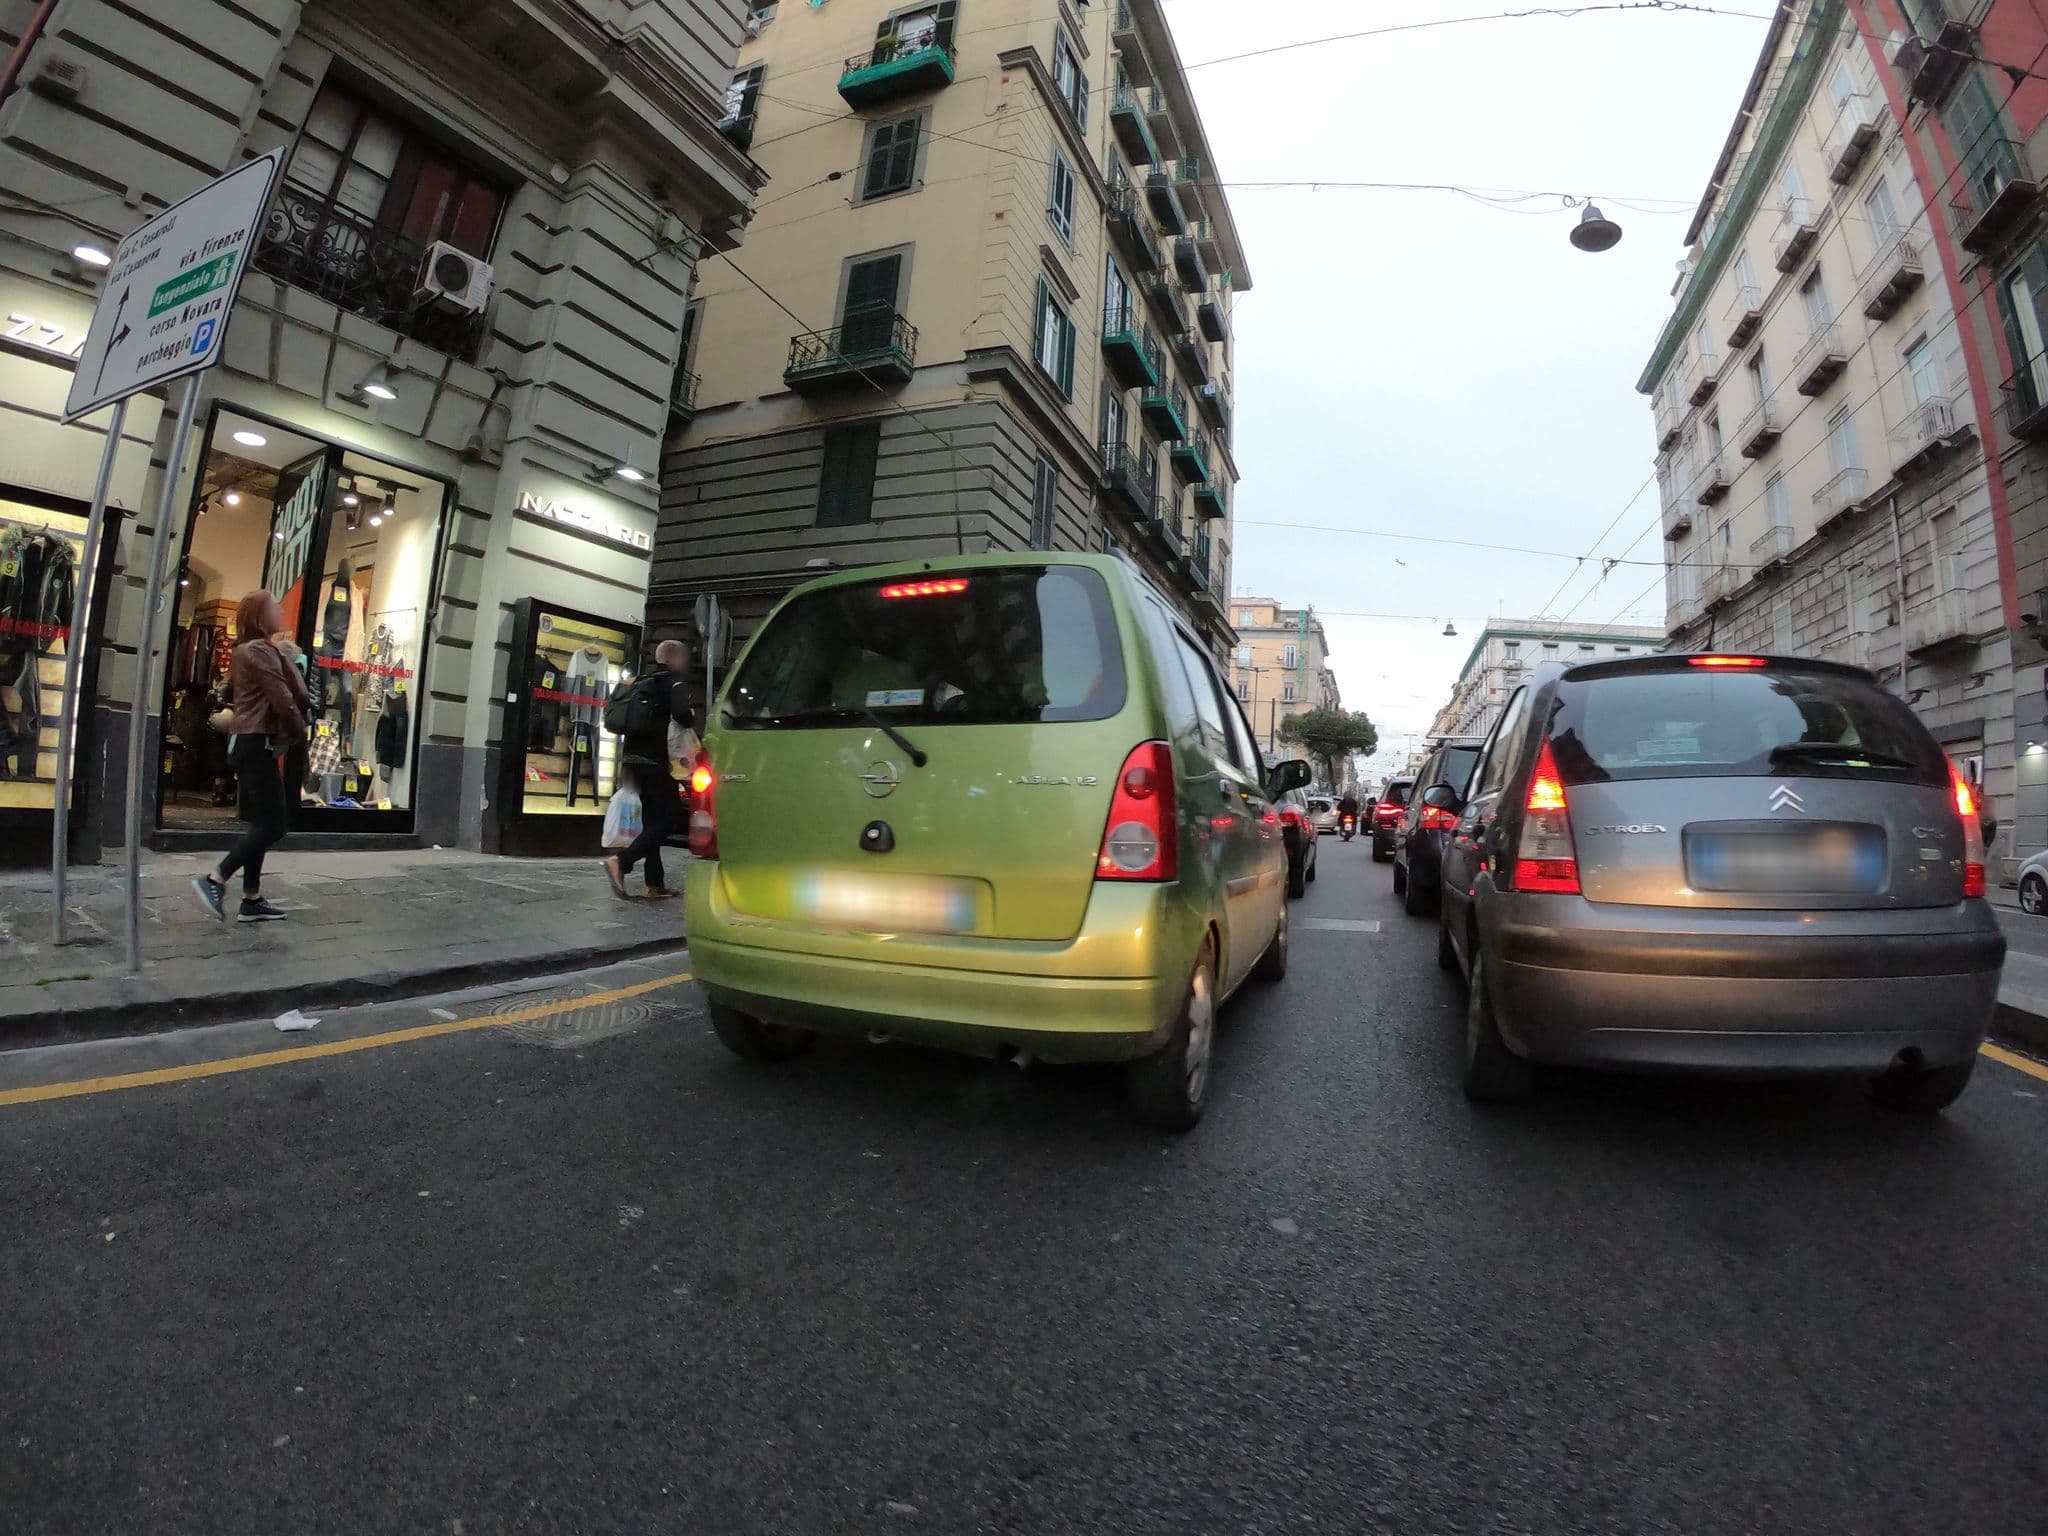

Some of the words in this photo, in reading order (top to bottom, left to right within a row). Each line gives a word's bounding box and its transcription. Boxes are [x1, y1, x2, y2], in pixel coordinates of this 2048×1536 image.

[180, 247, 197, 268] via
[200, 228, 245, 259] Firenze
[109, 272, 121, 286] via
[153, 270, 210, 308] tangenziale
[149, 316, 177, 338] corso
[181, 297, 222, 325] Novara
[136, 333, 192, 374] parcheggio
